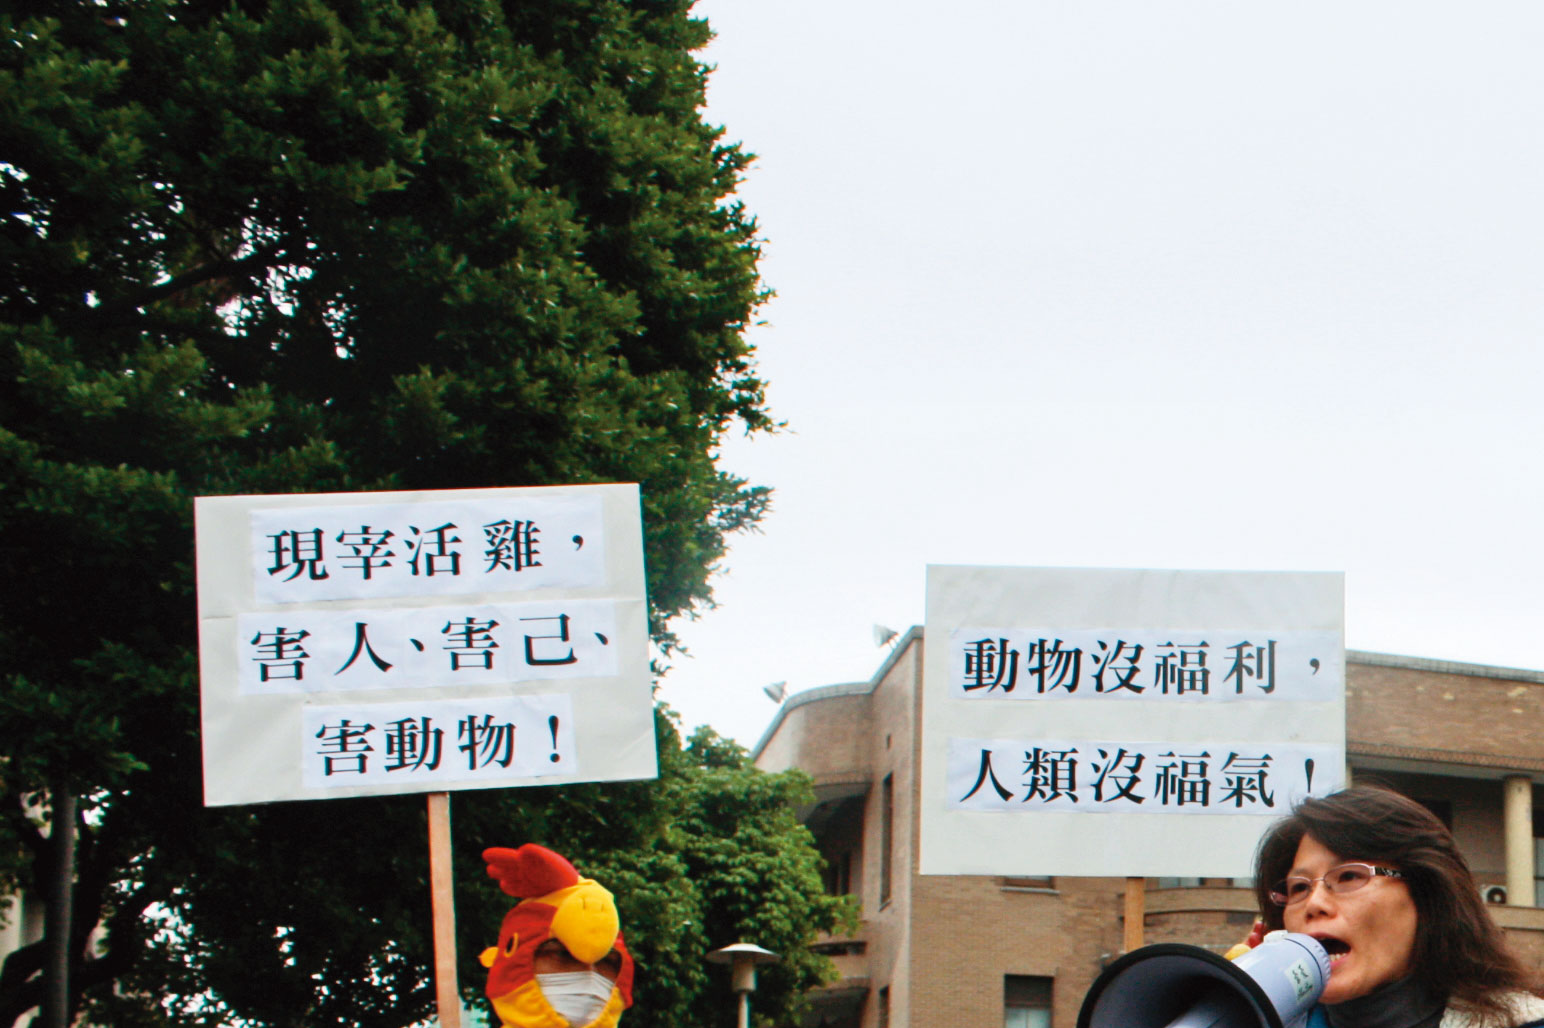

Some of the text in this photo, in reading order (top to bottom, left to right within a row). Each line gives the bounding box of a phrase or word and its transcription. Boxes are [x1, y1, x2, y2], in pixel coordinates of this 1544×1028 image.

[265, 519, 585, 582] 現宰活雞，
[250, 614, 609, 682] 害人、害己、
[962, 637, 1321, 695] 動物沒福利，
[316, 714, 561, 777] 害動物！
[960, 747, 1316, 808] 人類沒福氣！
